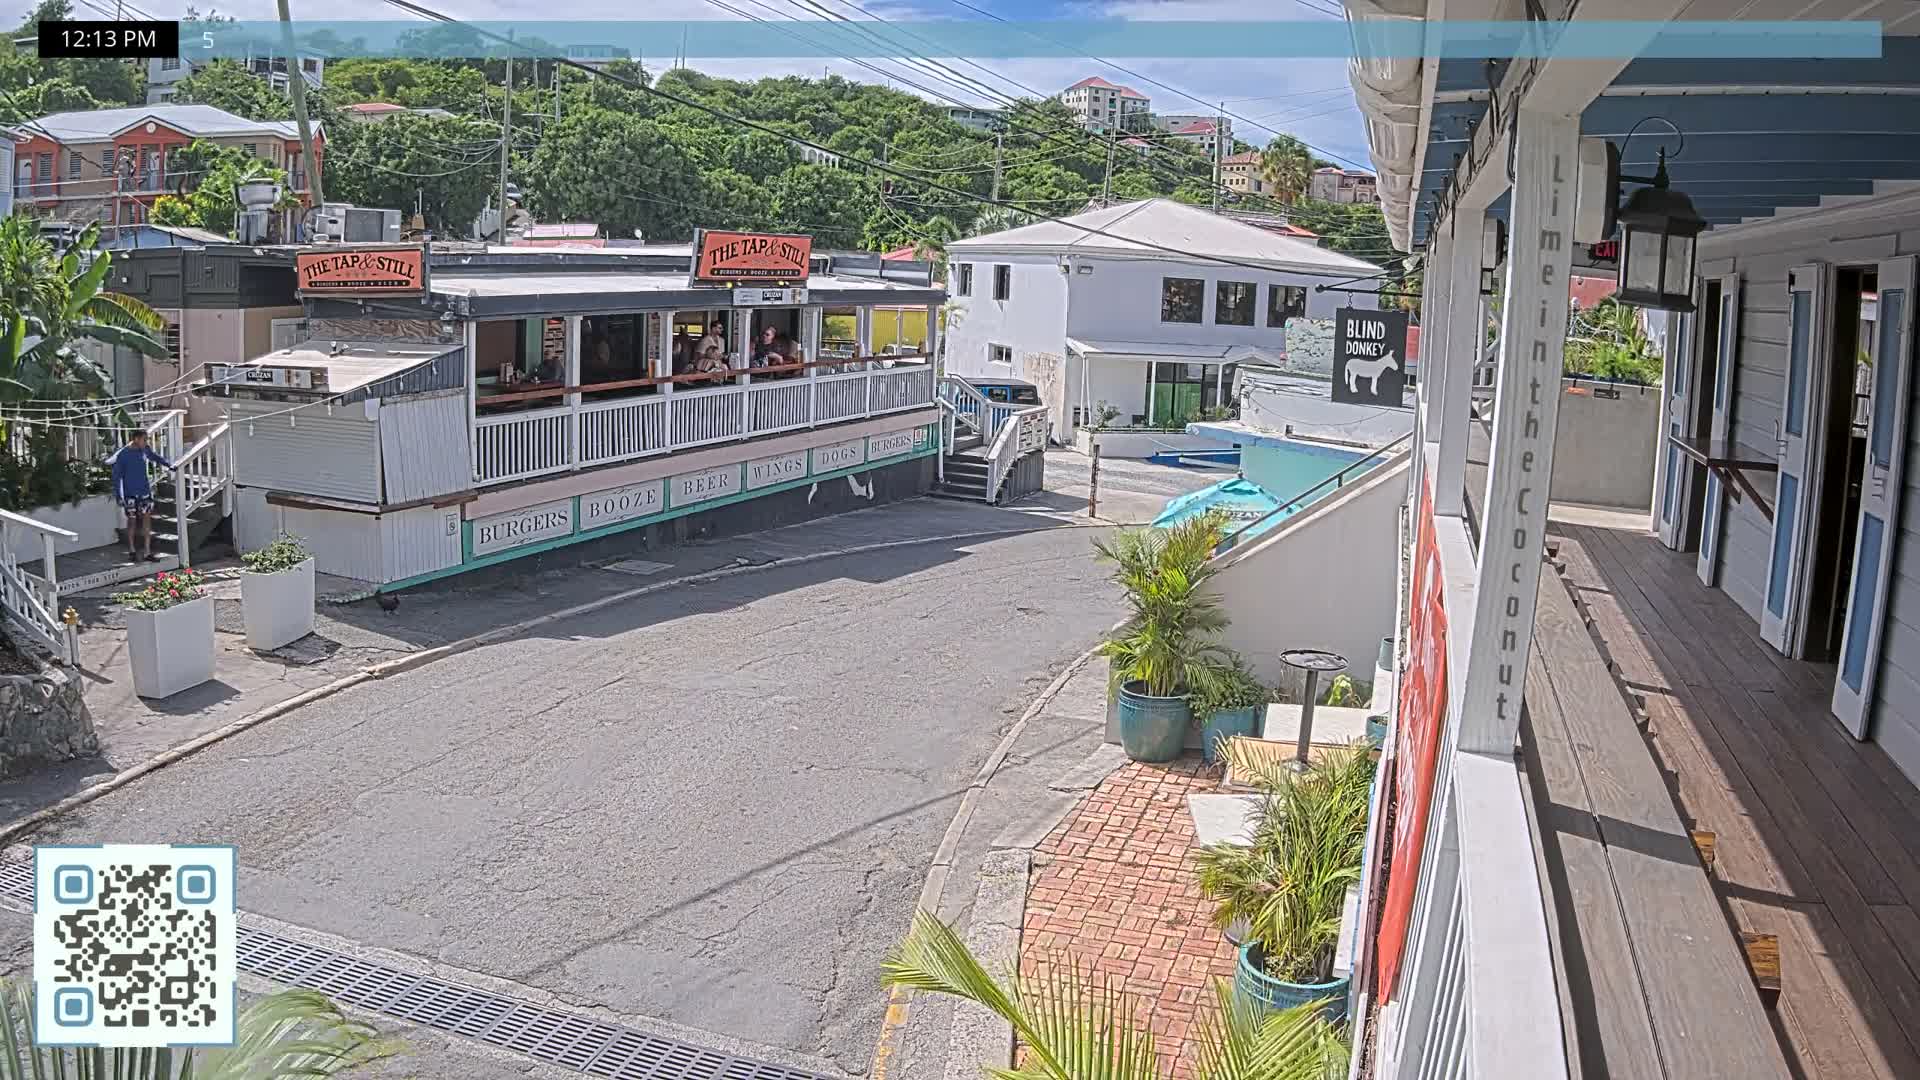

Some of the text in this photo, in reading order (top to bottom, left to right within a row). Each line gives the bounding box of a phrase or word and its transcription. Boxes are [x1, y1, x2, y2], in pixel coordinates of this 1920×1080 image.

[709, 238, 805, 269] THE TAP & STILL
[1595, 242, 1616, 257] EXI
[303, 253, 416, 280] THE TAP & STILL
[1346, 319, 1386, 340] BLIND
[1345, 340, 1386, 356] DONKEY
[821, 446, 857, 465] DOGS
[871, 435, 912, 454] BURGERS
[753, 458, 803, 480] WINGS
[683, 473, 729, 496] BEER
[589, 488, 657, 518] BOOZE
[479, 510, 569, 545] BURGERS
